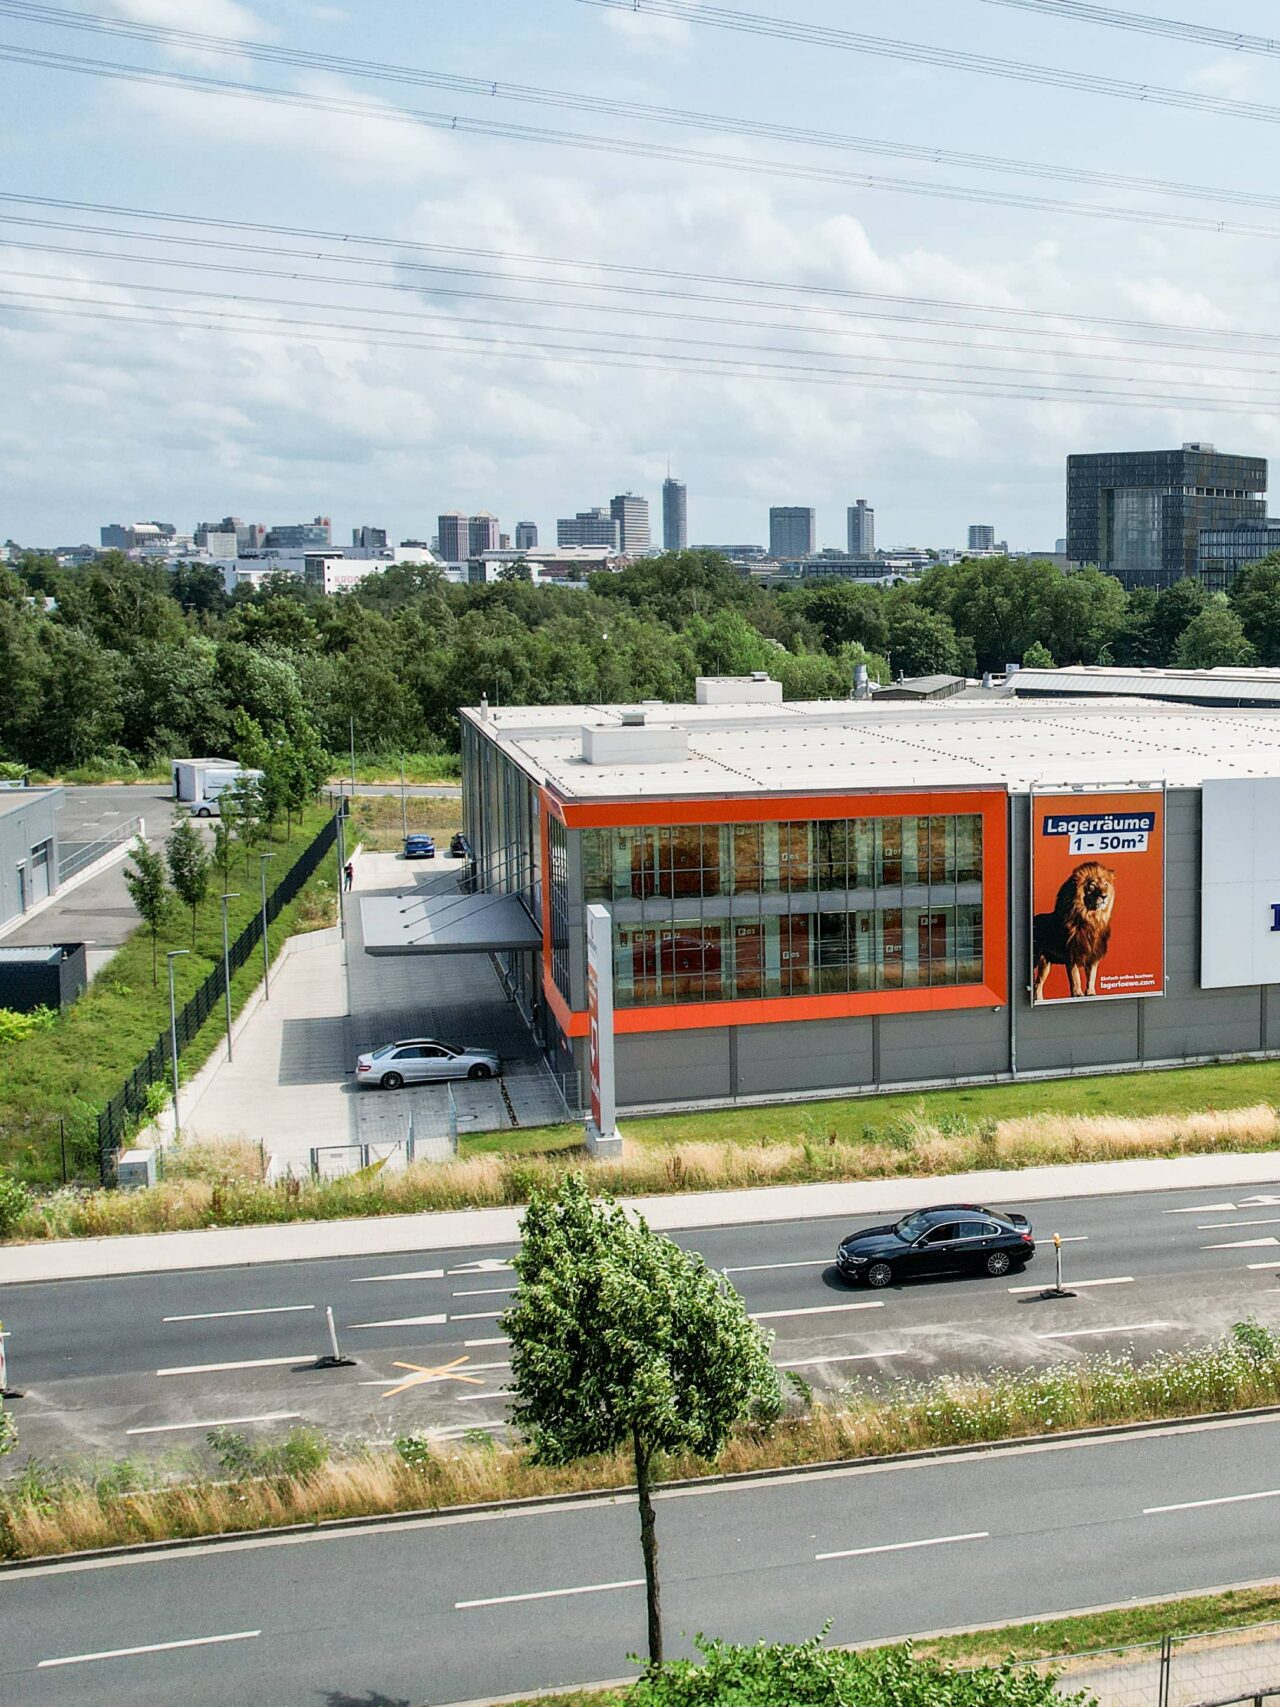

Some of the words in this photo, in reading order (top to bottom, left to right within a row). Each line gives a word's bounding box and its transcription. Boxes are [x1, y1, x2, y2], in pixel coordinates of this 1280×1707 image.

[1047, 815, 1150, 837] Lagerräume
[1074, 837, 1083, 851] 1
[1100, 980, 1156, 990] lagerloewe.com
